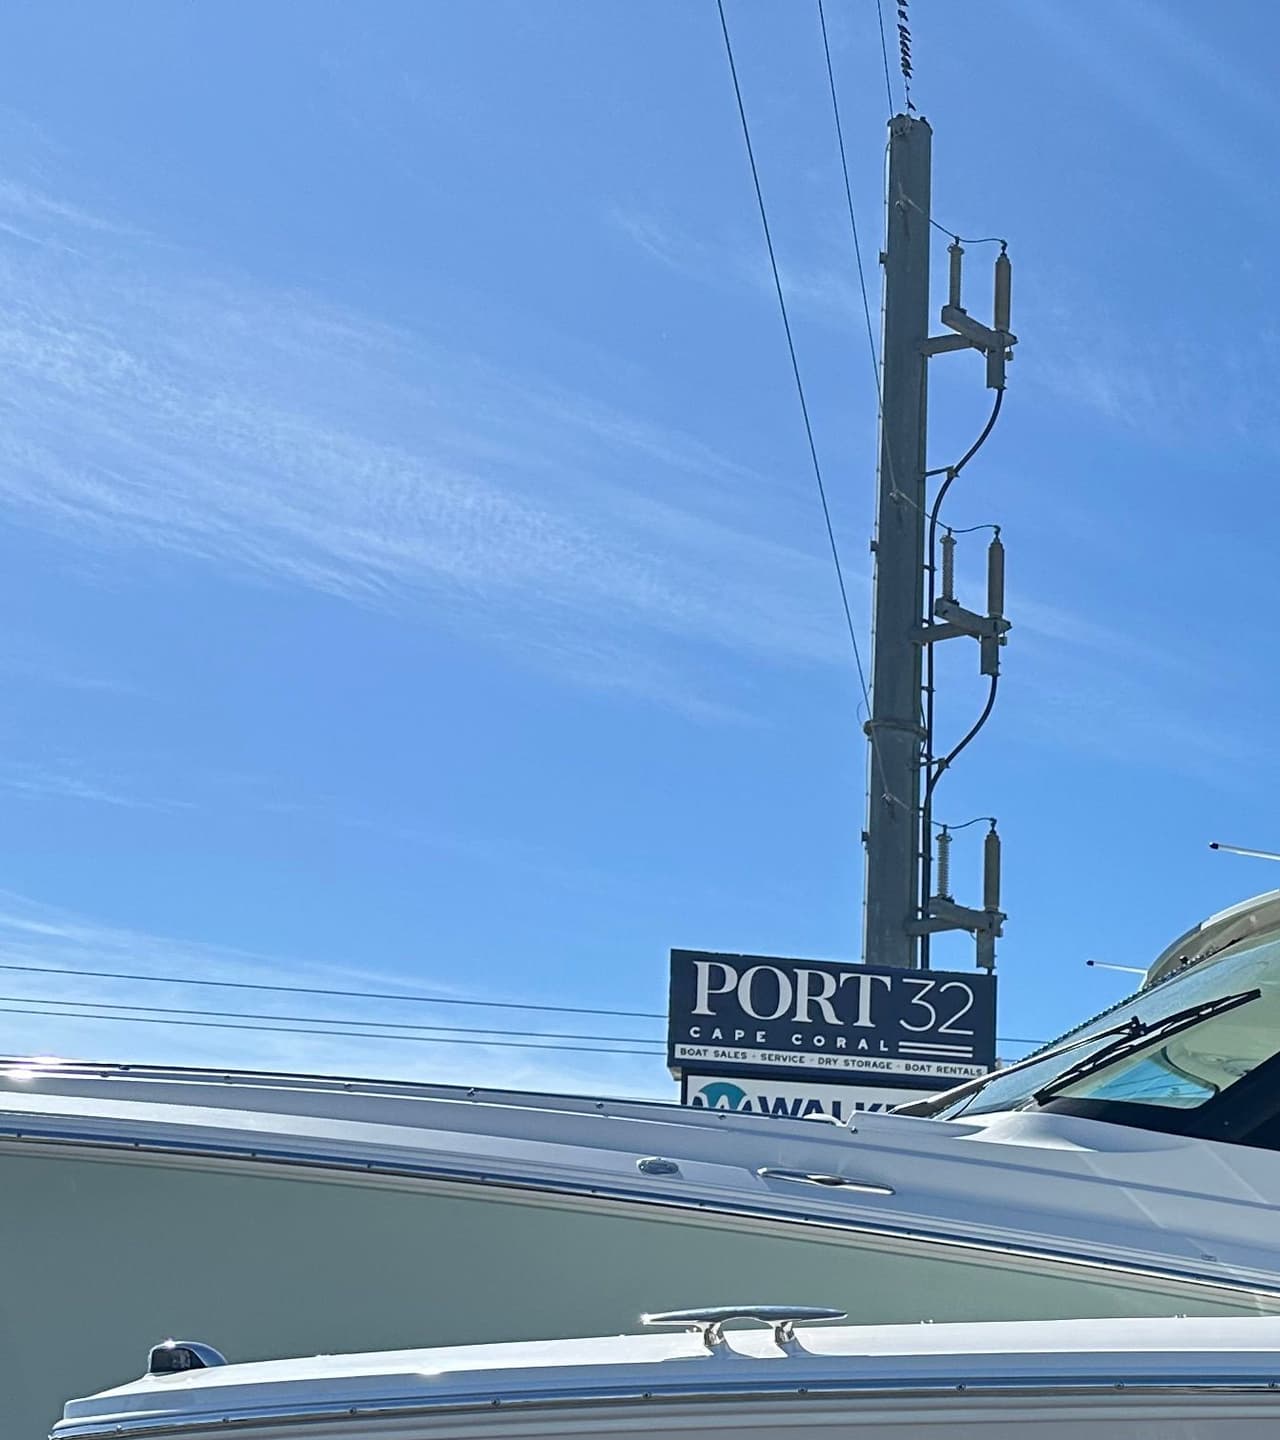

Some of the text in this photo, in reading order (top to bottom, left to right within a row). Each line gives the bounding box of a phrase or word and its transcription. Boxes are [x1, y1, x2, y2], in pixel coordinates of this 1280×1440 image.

[691, 960, 975, 1036] PORT 32
[689, 1026, 889, 1052] CAPE CORAL
[680, 1047, 983, 1077] BOAT SALES SERVICE DRY STORAGE BOAT RENTALS
